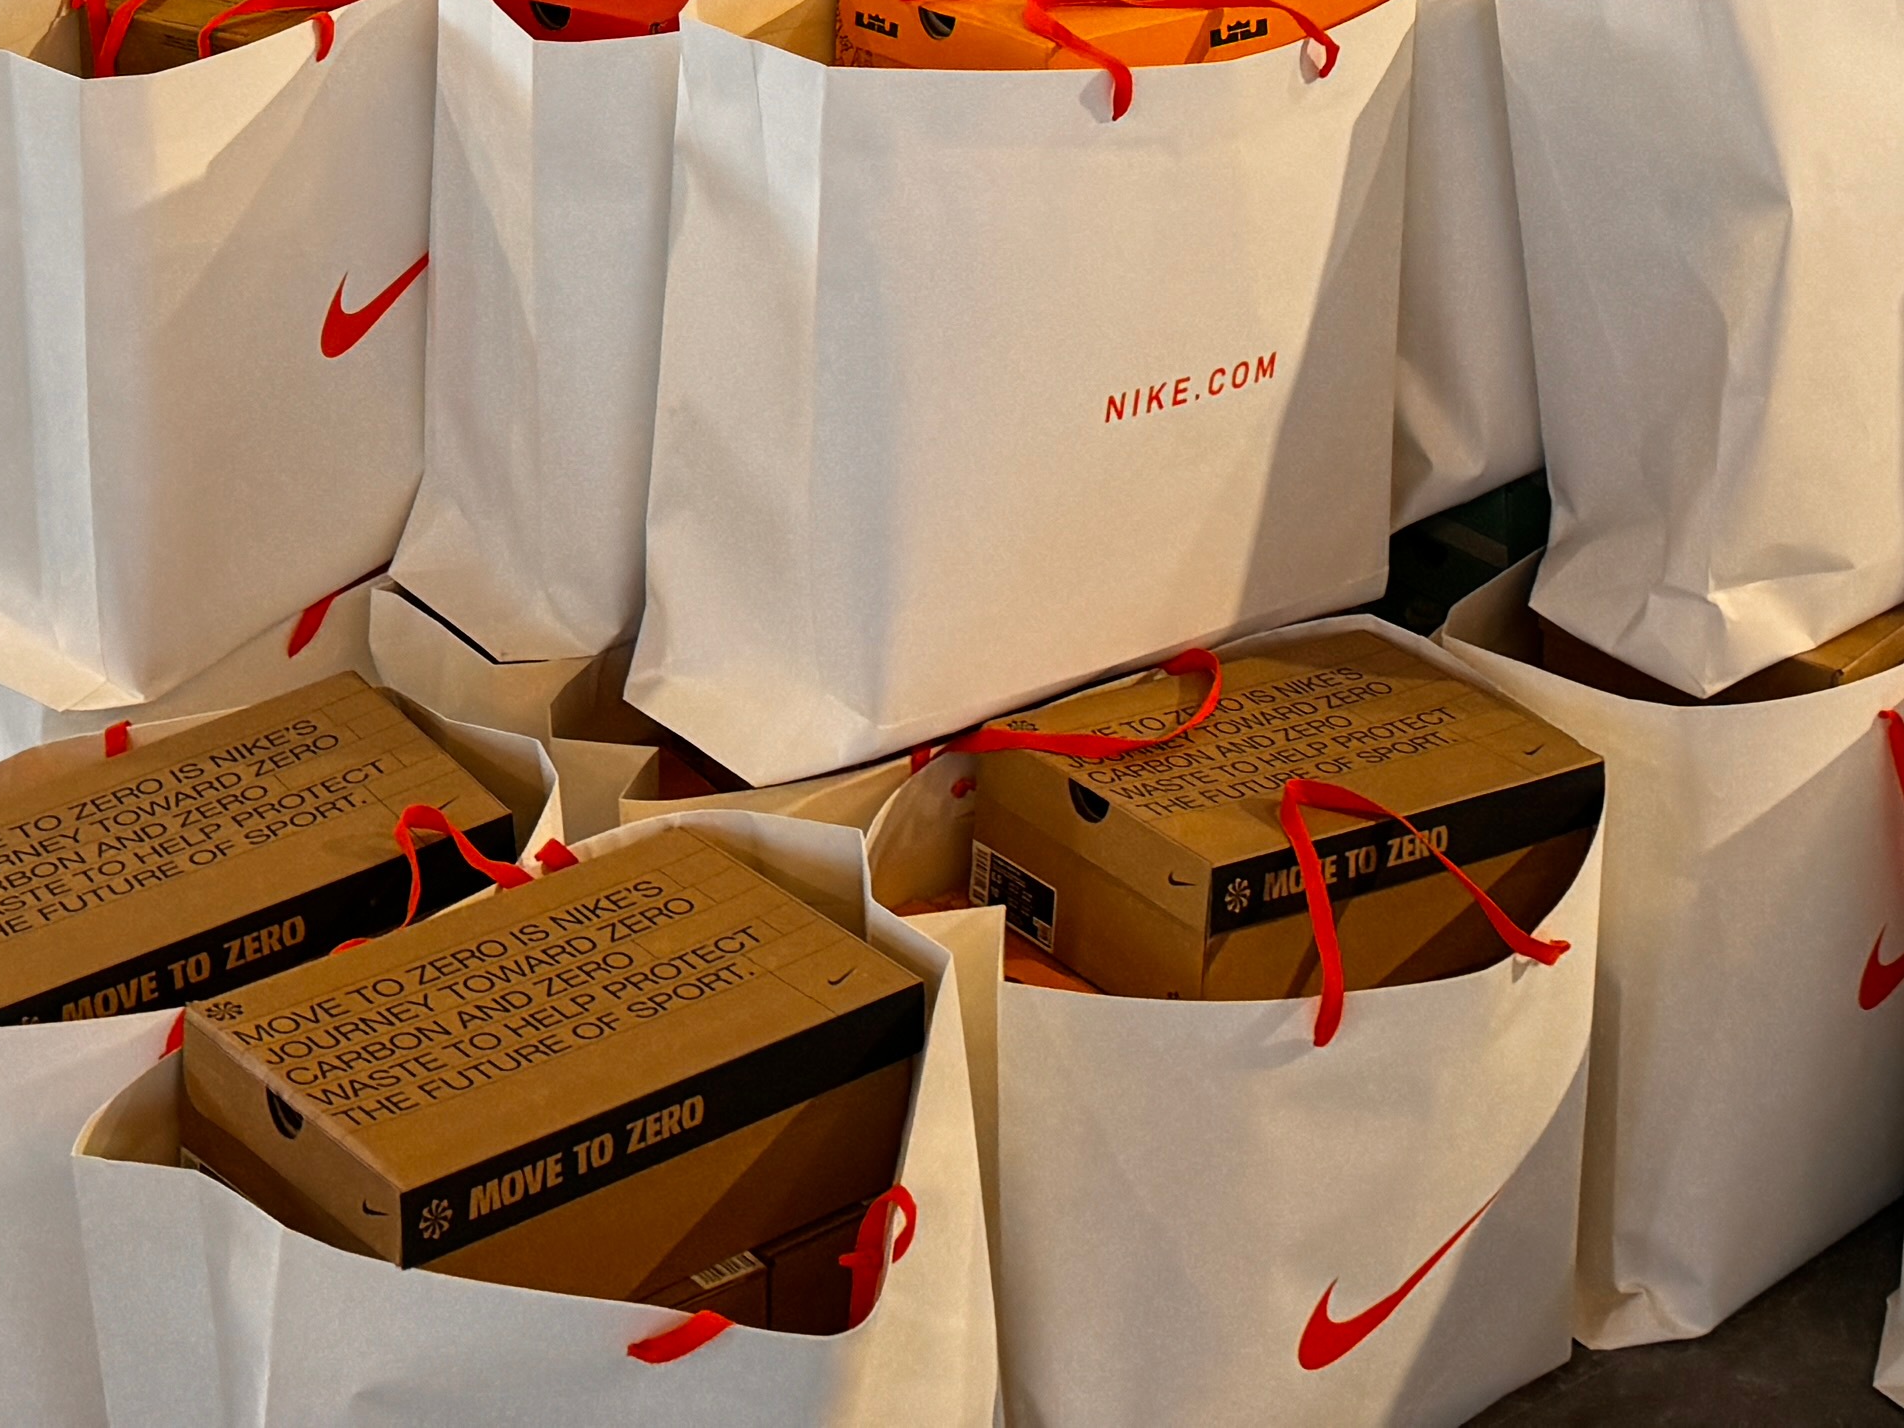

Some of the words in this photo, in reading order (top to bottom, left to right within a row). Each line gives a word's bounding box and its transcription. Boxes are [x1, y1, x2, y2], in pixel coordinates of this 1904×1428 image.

[1104, 351, 1278, 424] NIKE.COM
[1088, 749, 1215, 786] CARBON
[1216, 734, 1277, 760] AND
[1274, 714, 1354, 744] ZERO
[1109, 770, 1219, 804] WASTE
[1219, 760, 1260, 777] TO
[1257, 741, 1329, 768] HELP
[1325, 706, 1458, 751] PROTECT
[1120, 717, 1166, 738] TO
[1243, 690, 1277, 707] IS
[1274, 666, 1364, 700] NIKE'S
[1200, 700, 1319, 736] TOWARD
[1317, 681, 1394, 710] ZERO
[14, 814, 63, 841] TO
[69, 778, 164, 821] ZERO
[169, 763, 205, 785] IS
[209, 719, 319, 769] NIKE'S
[79, 858, 128, 883] TO
[134, 821, 227, 864] HELP
[227, 757, 386, 828] PROTECT
[88, 771, 247, 832] TOWARD
[246, 734, 341, 779] ZERO
[93, 822, 170, 858] AND
[179, 784, 270, 829] ZERO
[1136, 793, 1205, 819] THE
[1201, 768, 1310, 805] FUTURE
[1314, 756, 1356, 776] OF
[1357, 731, 1458, 765] SPORT.
[39, 861, 185, 922] FUTURE
[189, 841, 238, 868] OF
[242, 790, 368, 846] SPORT.
[1345, 844, 1378, 878] TO
[1386, 825, 1449, 868] ZERO
[61, 974, 159, 1023] MOVE
[168, 952, 211, 991] TO
[223, 915, 306, 971] ZERO
[231, 996, 354, 1047] MOVE
[346, 978, 405, 1007] TO
[405, 939, 509, 986] ZERO
[508, 922, 550, 947] IS
[549, 880, 664, 931] NIKE'S
[264, 992, 435, 1066] JOURNEY
[435, 935, 598, 999] TOWARD
[597, 896, 696, 943] ZERO
[306, 1051, 448, 1108] WASTE
[447, 1030, 505, 1057] TO
[503, 995, 596, 1042] HELP
[602, 926, 762, 1001] PROTECT
[286, 1020, 453, 1087] CARBON
[450, 990, 534, 1028] AND
[533, 951, 634, 1000] ZERO
[332, 1093, 421, 1130] THE
[418, 1036, 570, 1101] FUTURE
[571, 1012, 622, 1040] OF
[627, 962, 755, 1020] SPORT.
[469, 1150, 564, 1221] MOVE
[572, 1135, 615, 1176] TO
[626, 1095, 705, 1156] ZERO
